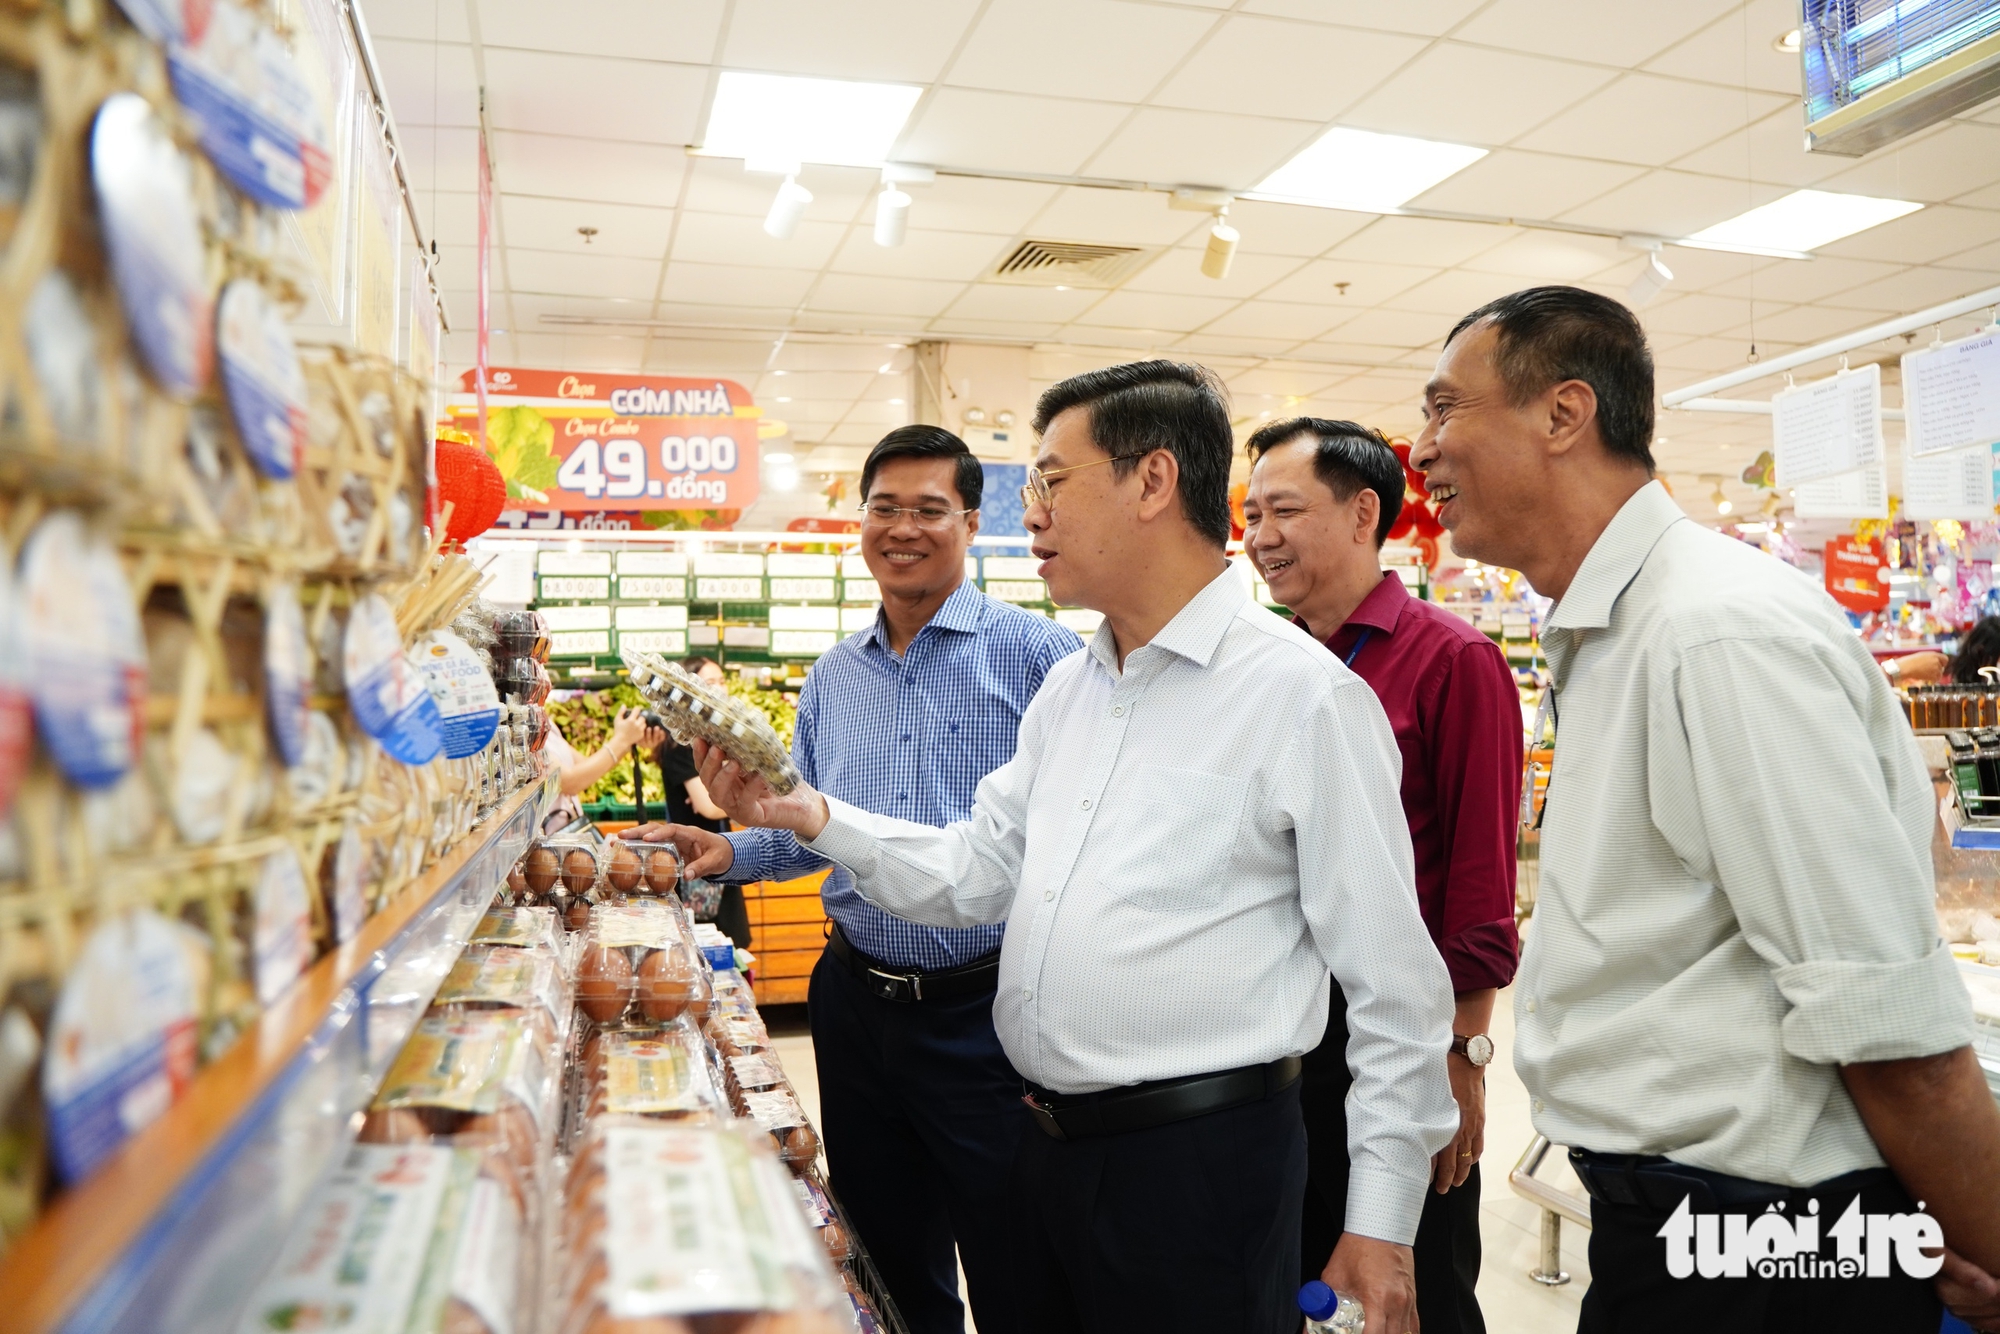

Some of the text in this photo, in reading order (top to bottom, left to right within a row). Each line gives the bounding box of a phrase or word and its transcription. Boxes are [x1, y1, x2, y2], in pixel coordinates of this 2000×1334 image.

[557, 376, 733, 415] Chọn CƠM NHÀ
[565, 417, 640, 438] Chọn Combo
[666, 470, 727, 504] đồng
